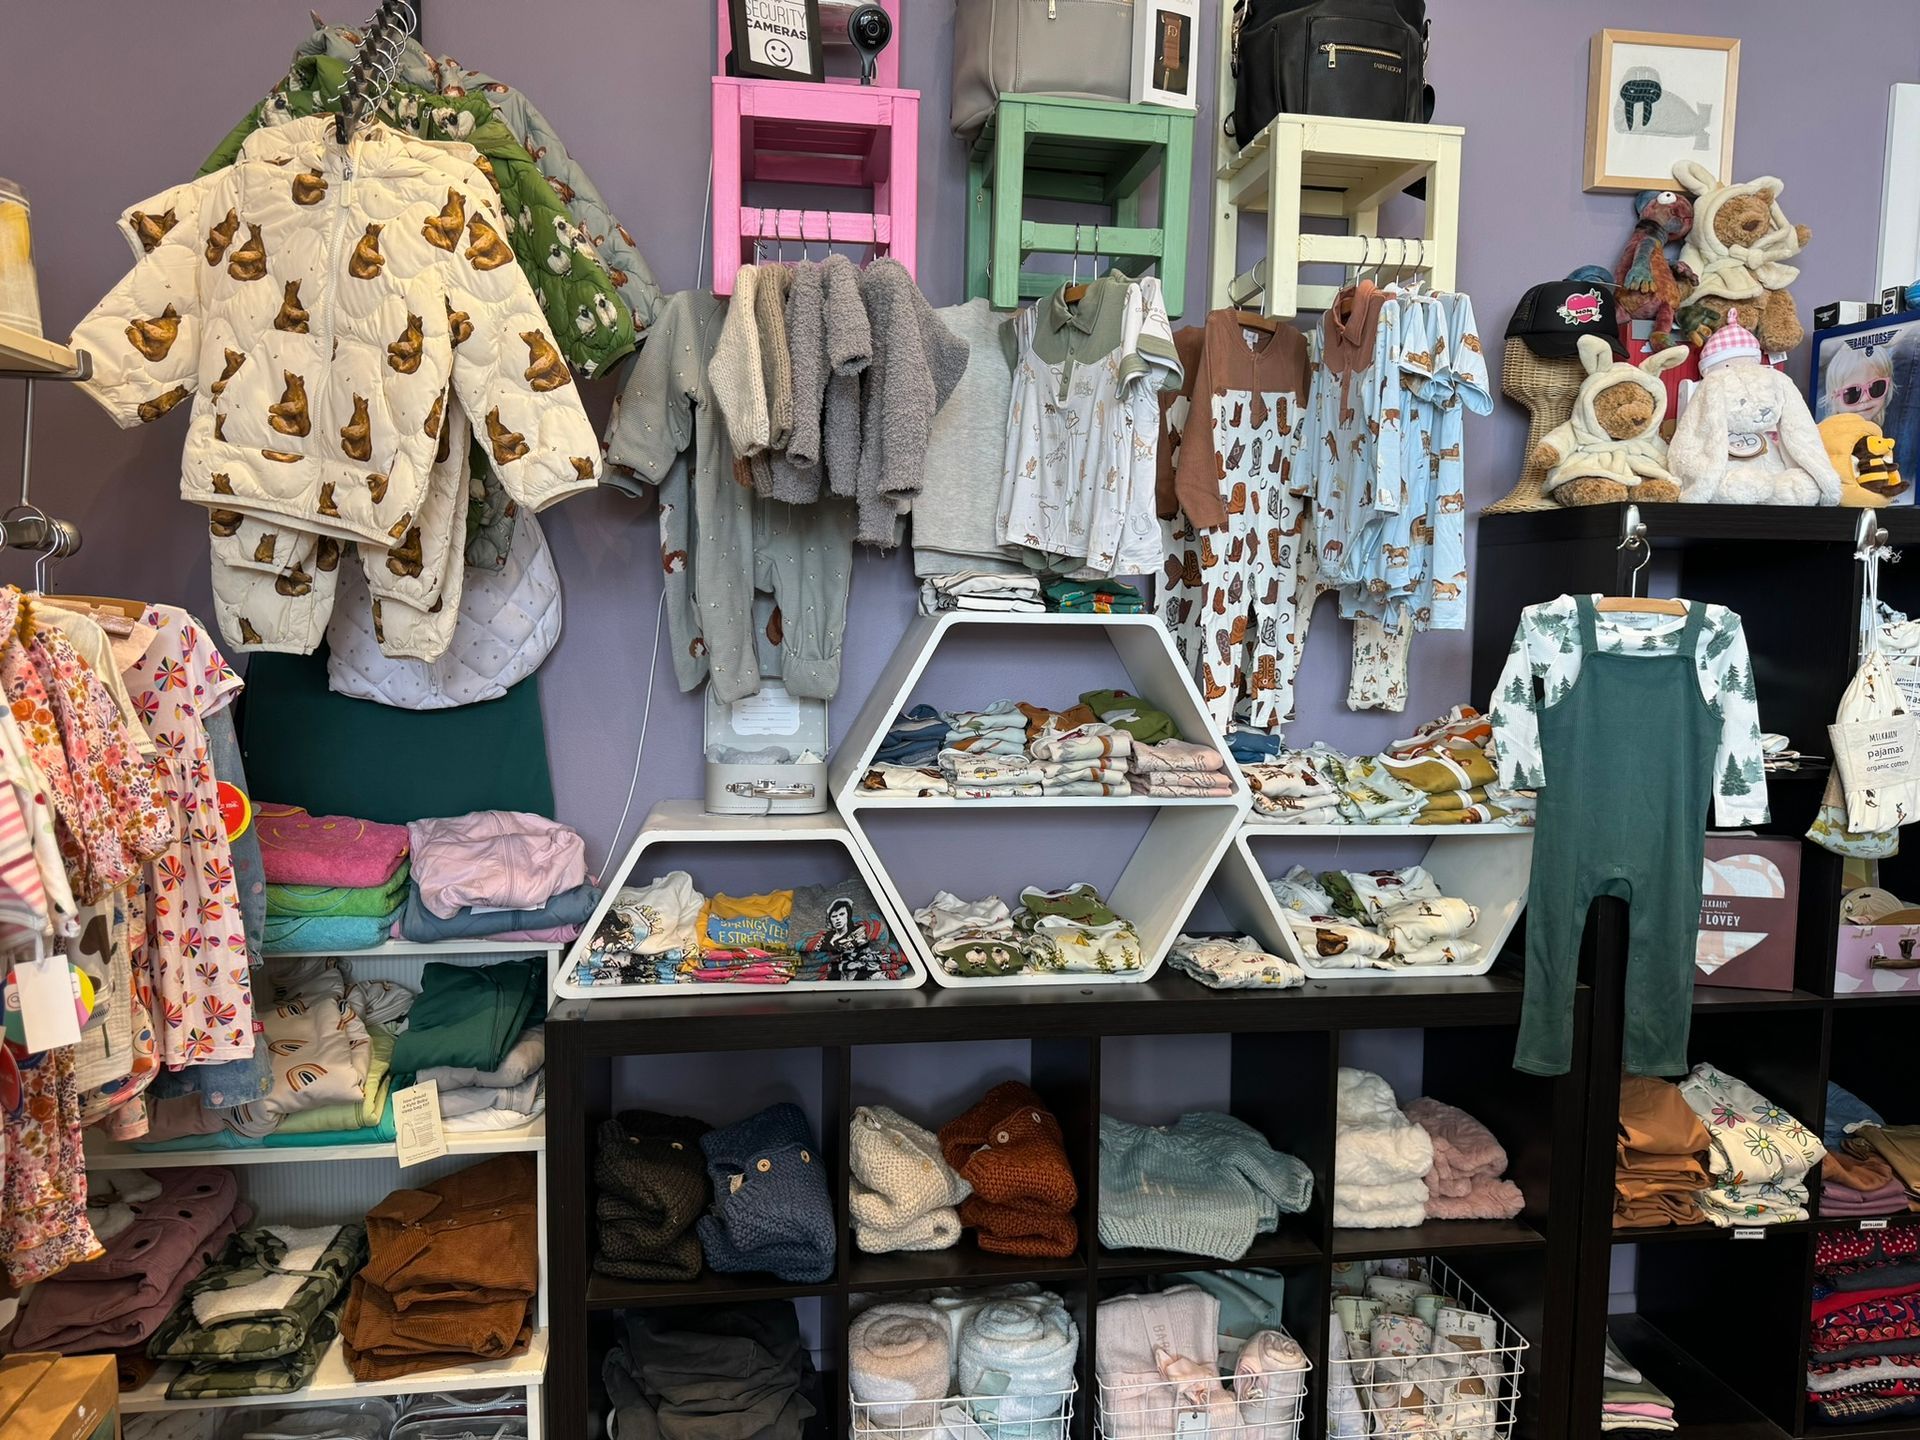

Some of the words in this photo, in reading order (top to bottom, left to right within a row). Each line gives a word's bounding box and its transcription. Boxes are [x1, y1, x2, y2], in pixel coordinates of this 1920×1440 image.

[746, 0, 806, 29] SECURITY
[746, 18, 807, 40] CAMERAS
[1852, 331, 1888, 348] BABIATORS
[1867, 745, 1904, 760] pajamas
[1866, 762, 1890, 772] organic
[1890, 759, 1909, 768] cotton
[1705, 914, 1740, 927] LOVEY
